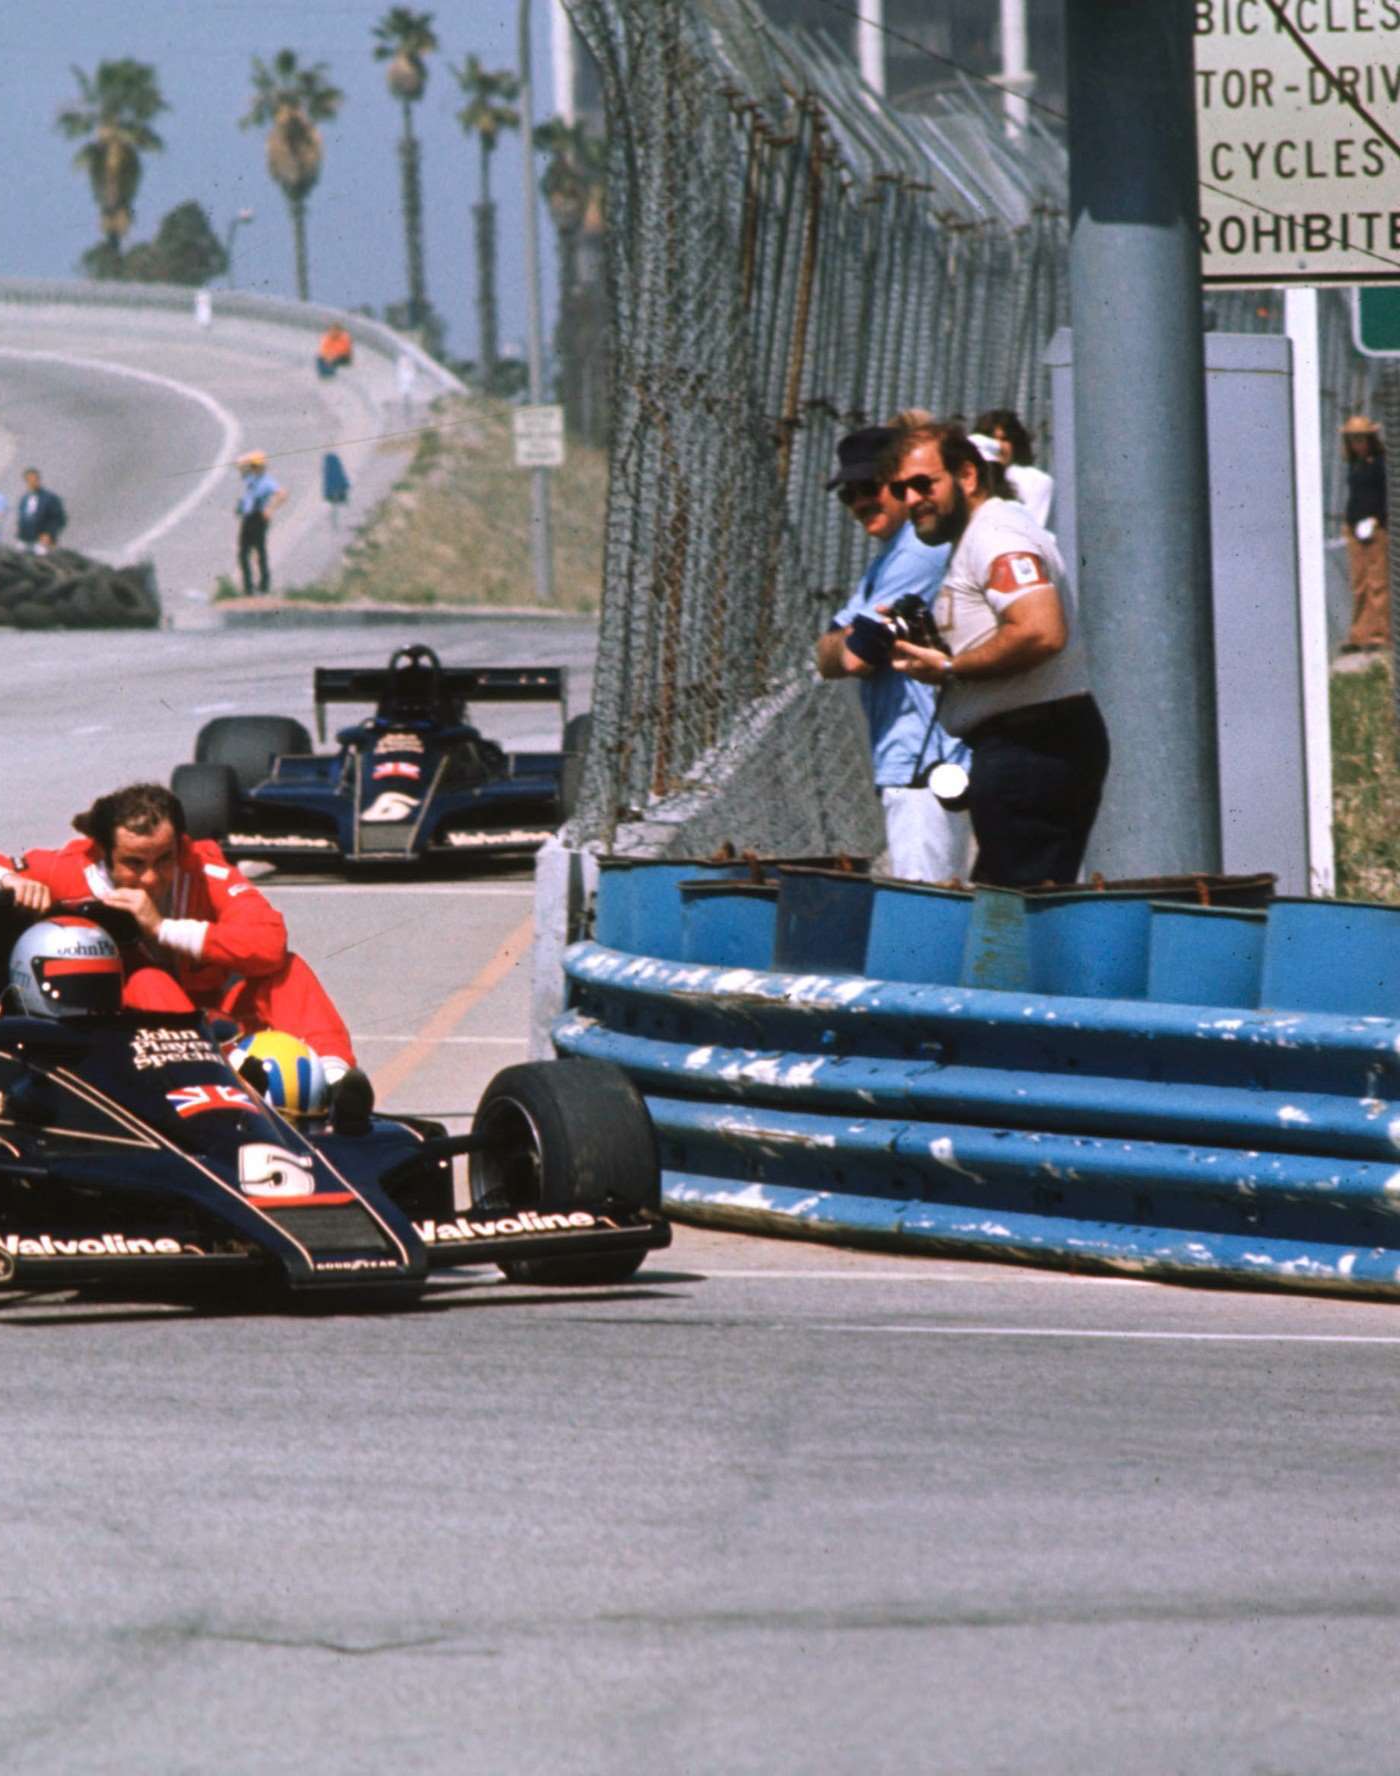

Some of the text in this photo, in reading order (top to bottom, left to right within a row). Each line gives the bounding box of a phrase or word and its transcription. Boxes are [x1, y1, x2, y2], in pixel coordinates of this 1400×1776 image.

[1211, 139, 1384, 181] CYCLES
[359, 791, 421, 822] 6
[129, 1040, 213, 1055] Player
[135, 1027, 200, 1041] John
[238, 1143, 315, 1198] 5
[411, 1210, 595, 1243] Valvoline
